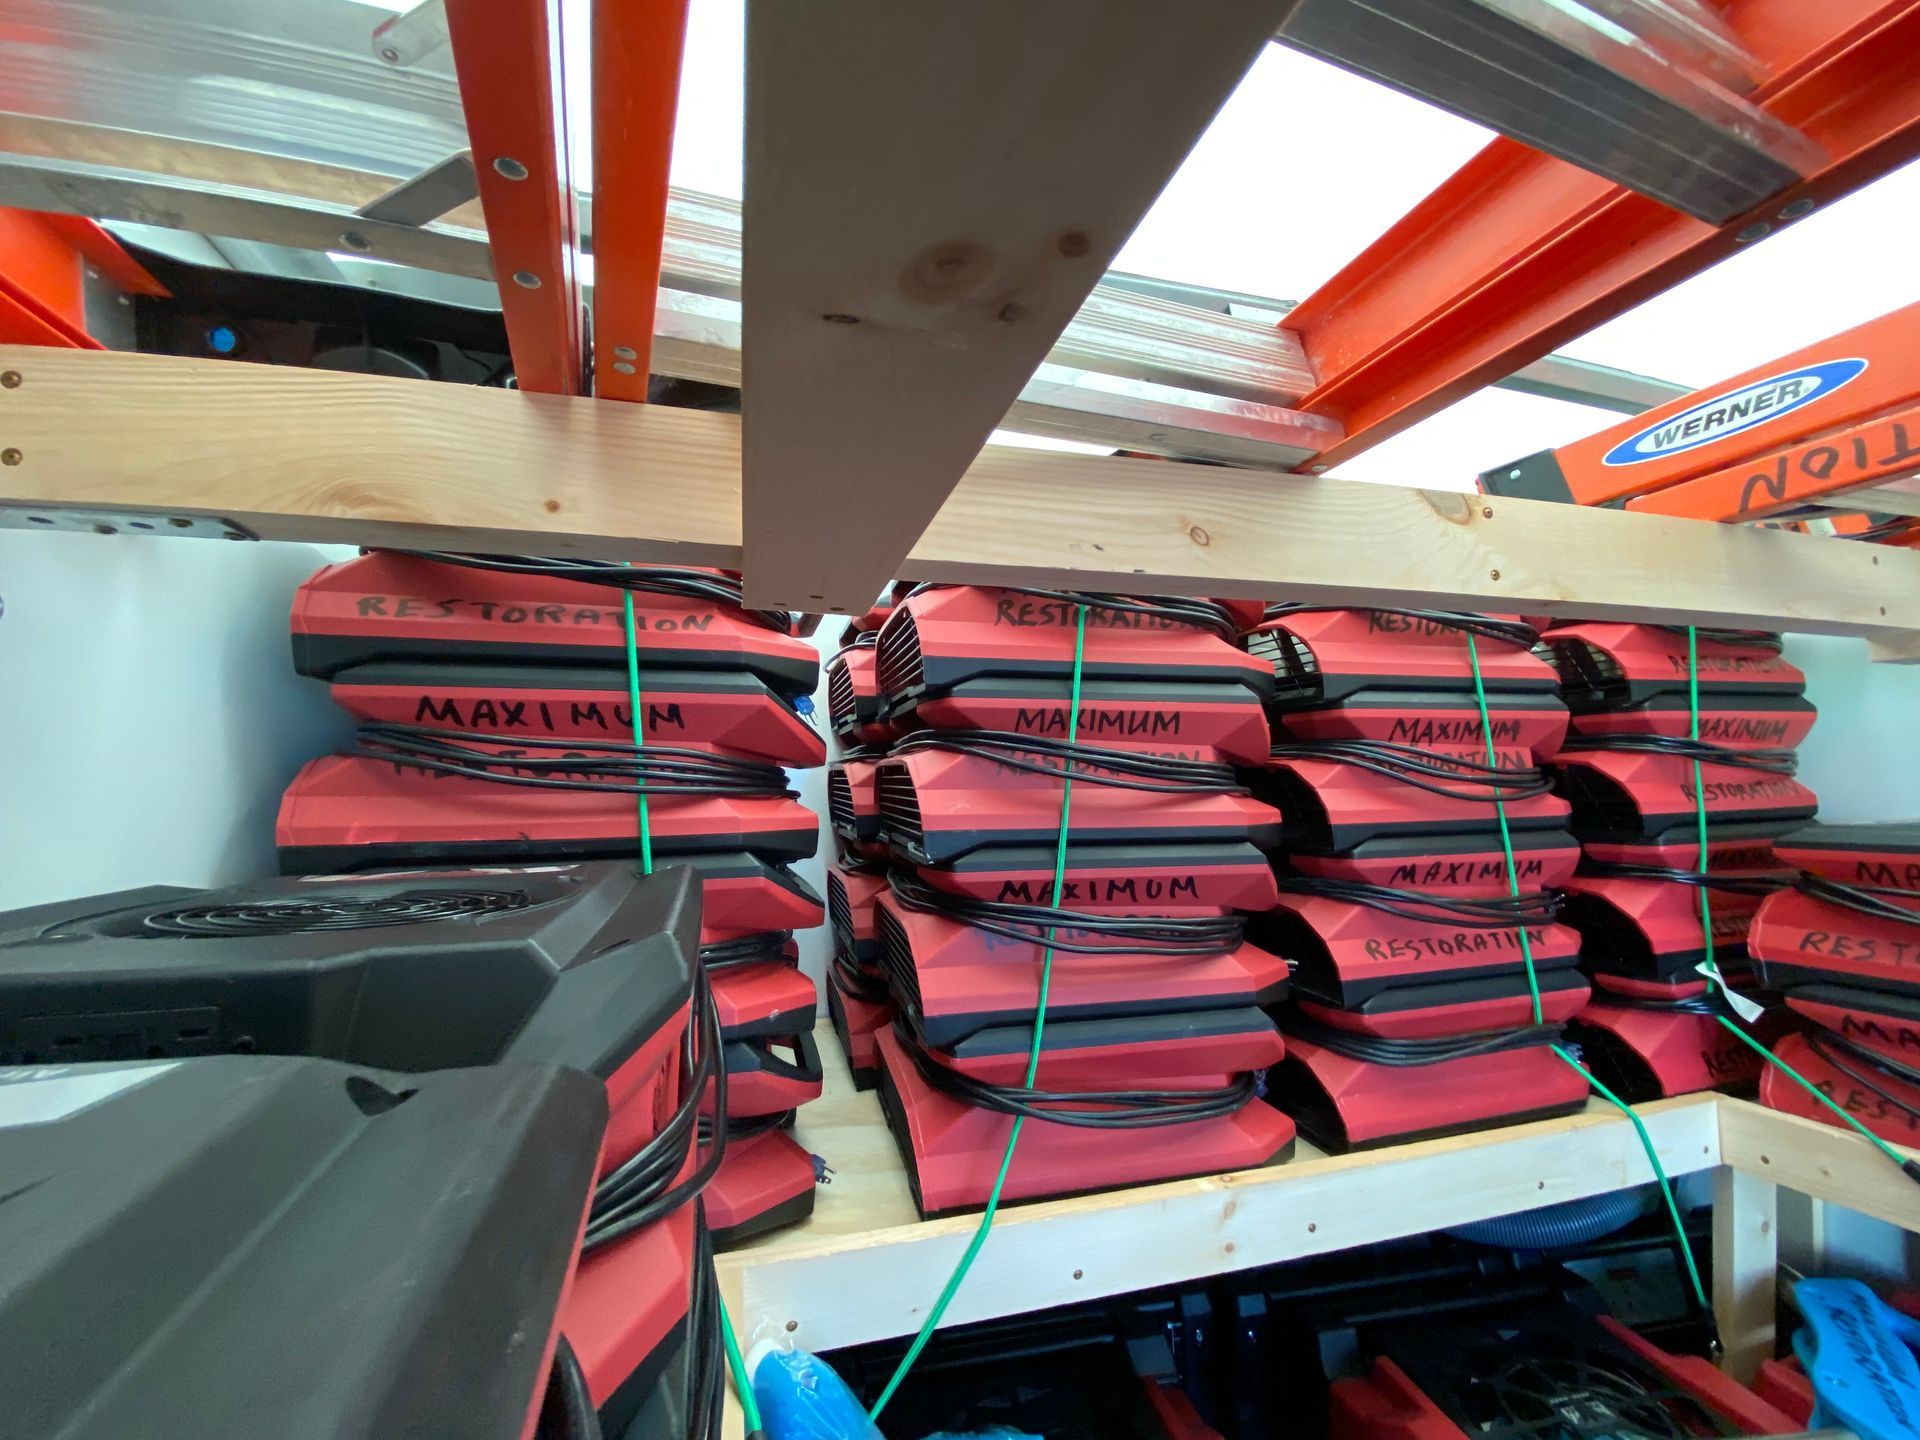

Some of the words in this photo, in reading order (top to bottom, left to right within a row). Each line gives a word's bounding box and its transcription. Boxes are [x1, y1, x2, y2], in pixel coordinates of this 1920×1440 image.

[1653, 379, 1805, 449] WERNER
[415, 696, 684, 731] MAXIMUM
[1014, 708, 1181, 736] MAXIMUM
[997, 876, 1200, 903] MAXIMUM
